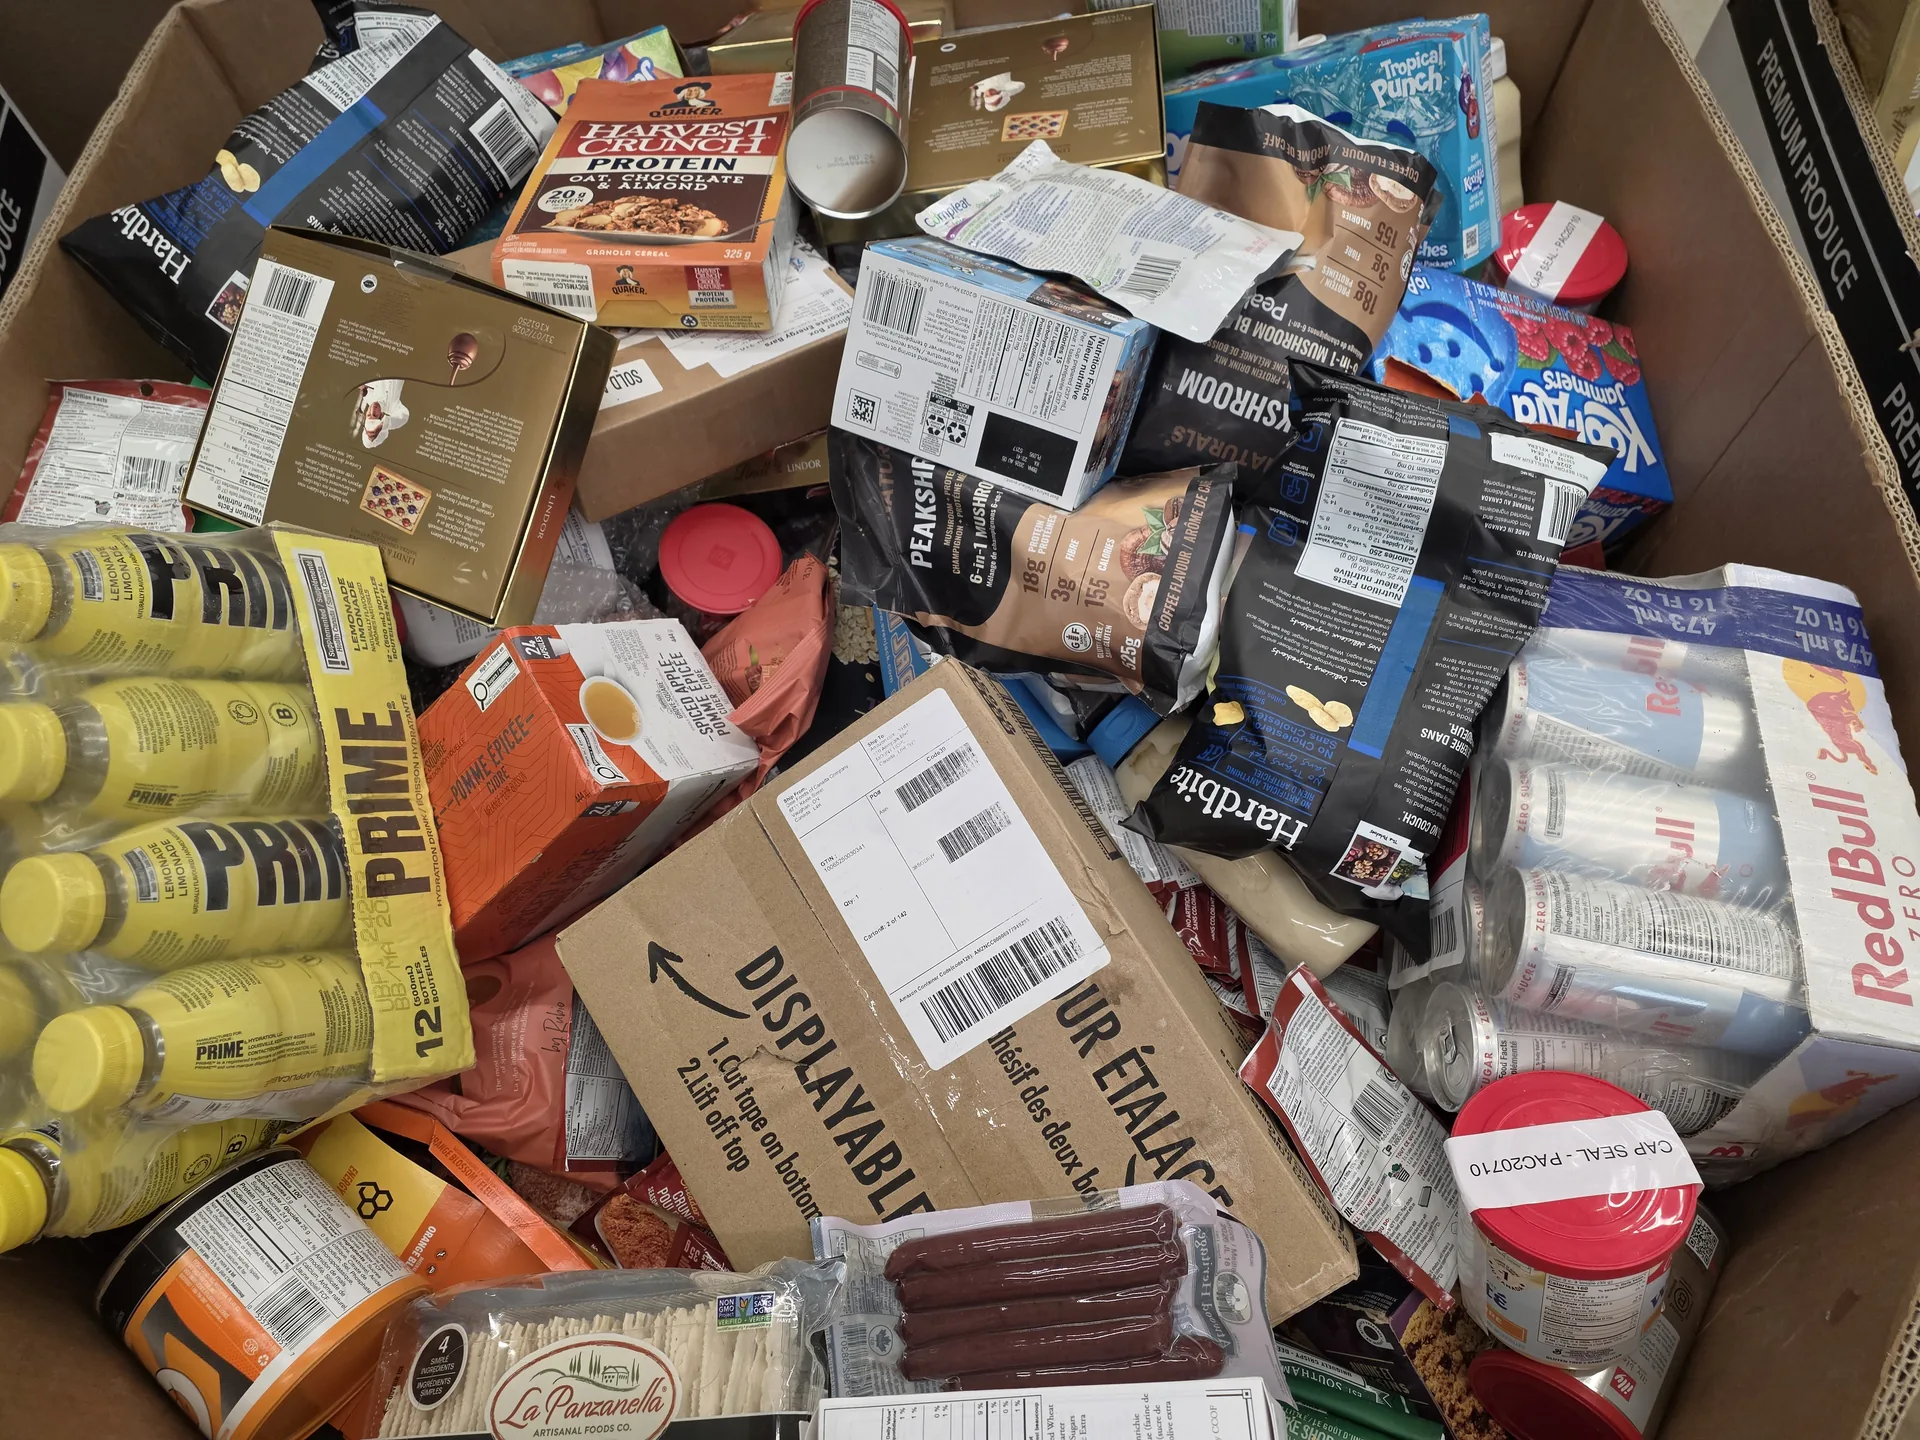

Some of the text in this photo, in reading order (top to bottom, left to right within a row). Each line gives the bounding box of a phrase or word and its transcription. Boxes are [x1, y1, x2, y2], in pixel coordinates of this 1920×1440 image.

[1380, 43, 1445, 80] Tropical
[1370, 69, 1443, 108] Punch
[579, 117, 778, 140] HARVEST
[649, 106, 722, 119] QUAKER
[576, 136, 766, 156] CRUNCH
[569, 172, 744, 185] OAT, CHOCOLATE
[586, 157, 738, 172] PROTEIN
[1341, 145, 1420, 183] COFFEE FLAVOUR
[1756, 39, 1858, 302] PREMIUM PRODUCE
[548, 189, 574, 200] 20
[613, 181, 708, 192] ALMOND
[1341, 210, 1372, 230] CALORIES
[1374, 221, 1399, 249] 155
[586, 249, 670, 258] GRANOLA CEREAL
[723, 249, 743, 259] 325
[1344, 245, 1361, 261] FIBRE
[1370, 253, 1391, 282] 3g
[611, 283, 648, 296] QUAKER
[1320, 265, 1354, 285] PROTÉINES
[1326, 277, 1351, 297] PROTEIN
[1531, 271, 1544, 289] CAP
[1352, 280, 1378, 316] 18g
[510, 324, 555, 344] 31/07/2026
[1056, 325, 1071, 354] Calories
[1252, 319, 1331, 363] MUSHROOM
[610, 369, 643, 390] SOLD
[1070, 333, 1097, 400] Valeur nutritive
[1079, 336, 1106, 402] Nutrition Facts
[1214, 354, 1250, 376] DRINK MIX
[1542, 369, 1625, 407] Jammers
[786, 458, 822, 472] LINDOR
[1480, 494, 1502, 503] CANADA
[940, 502, 957, 546] MUSHROOM
[948, 482, 968, 574] CHAMPIGNON PROTÉINE
[1028, 522, 1042, 554] PROTEIN
[1039, 514, 1057, 555] PROTÉINES
[1483, 522, 1530, 536] MADE CANADA
[968, 542, 988, 584] 6-in-1
[984, 508, 1002, 587] Mélange champignons
[1065, 538, 1080, 562] FIBRE
[1098, 538, 1115, 572] CALORIES
[1368, 548, 1415, 565] Calories 250
[1022, 558, 1047, 595] 18g
[1158, 511, 1202, 632] COFFEE FLAVOUR ARÔME
[1331, 574, 1402, 601] Nutrition Facts
[1332, 566, 1405, 592] Valeur nutritive
[1051, 576, 1077, 602] 3g
[1084, 577, 1111, 609] 155
[1622, 585, 1717, 613] 16 FL OZ
[337, 576, 362, 652] LEMONADE
[347, 580, 369, 650] LIMONADE
[1288, 616, 1330, 636] ingrédients
[1626, 604, 1717, 637] 473 mL
[1794, 605, 1870, 640] 16 FL OZ
[315, 607, 336, 658] Supplemented
[524, 639, 540, 657] 24
[534, 635, 552, 660] CAPSULES
[1120, 635, 1142, 672] 525g
[1268, 646, 1349, 683] Delicious Ingredients
[1797, 630, 1874, 668] 473 mL
[657, 653, 714, 738] SPICED APPLE
[667, 646, 730, 740] POMME ÉPICÉE
[693, 665, 728, 716] CIDER CIDRE
[444, 710, 534, 807] POMME ÉPICÉE
[925, 746, 948, 762] Code39
[482, 763, 512, 796] CIDRE
[868, 789, 882, 800] PO#
[335, 707, 431, 898] PRIME
[399, 691, 446, 907] HYDRATION DRINK HYDRATANTE
[1170, 765, 1308, 851] Hardbite
[820, 855, 835, 867] GTIN
[842, 896, 856, 909] Qty:
[1808, 783, 1914, 1008] Red Bull
[1533, 900, 1548, 932] ZERO
[405, 964, 422, 1007] (500mL)
[414, 960, 430, 1005] BOTTLES
[419, 944, 439, 1004] BOUTEILLES
[408, 1005, 448, 1058] 12
[541, 1000, 570, 1033] Rubio
[197, 1040, 244, 1061] PRIME
[677, 1057, 751, 1173] 2.Lift off top
[734, 1087, 768, 1132] tape
[760, 1131, 784, 1160] on
[1020, 1084, 1083, 1176] des deux
[1469, 1139, 1674, 1179] CAP SEAL PAC20710
[269, 1165, 294, 1190] Calories
[338, 1164, 359, 1196] ENERGY
[218, 1192, 243, 1218] Potassium
[228, 1186, 249, 1207] Sodium
[718, 1298, 735, 1306] NON
[718, 1305, 736, 1313] GMO
[429, 1355, 450, 1367] SIMPLE
[438, 1336, 450, 1354] 4
[419, 1386, 443, 1398] SIMPLES
[499, 1376, 667, 1430] La Panzanella
[533, 1423, 632, 1438] ARTISANAL FOODS CO.
